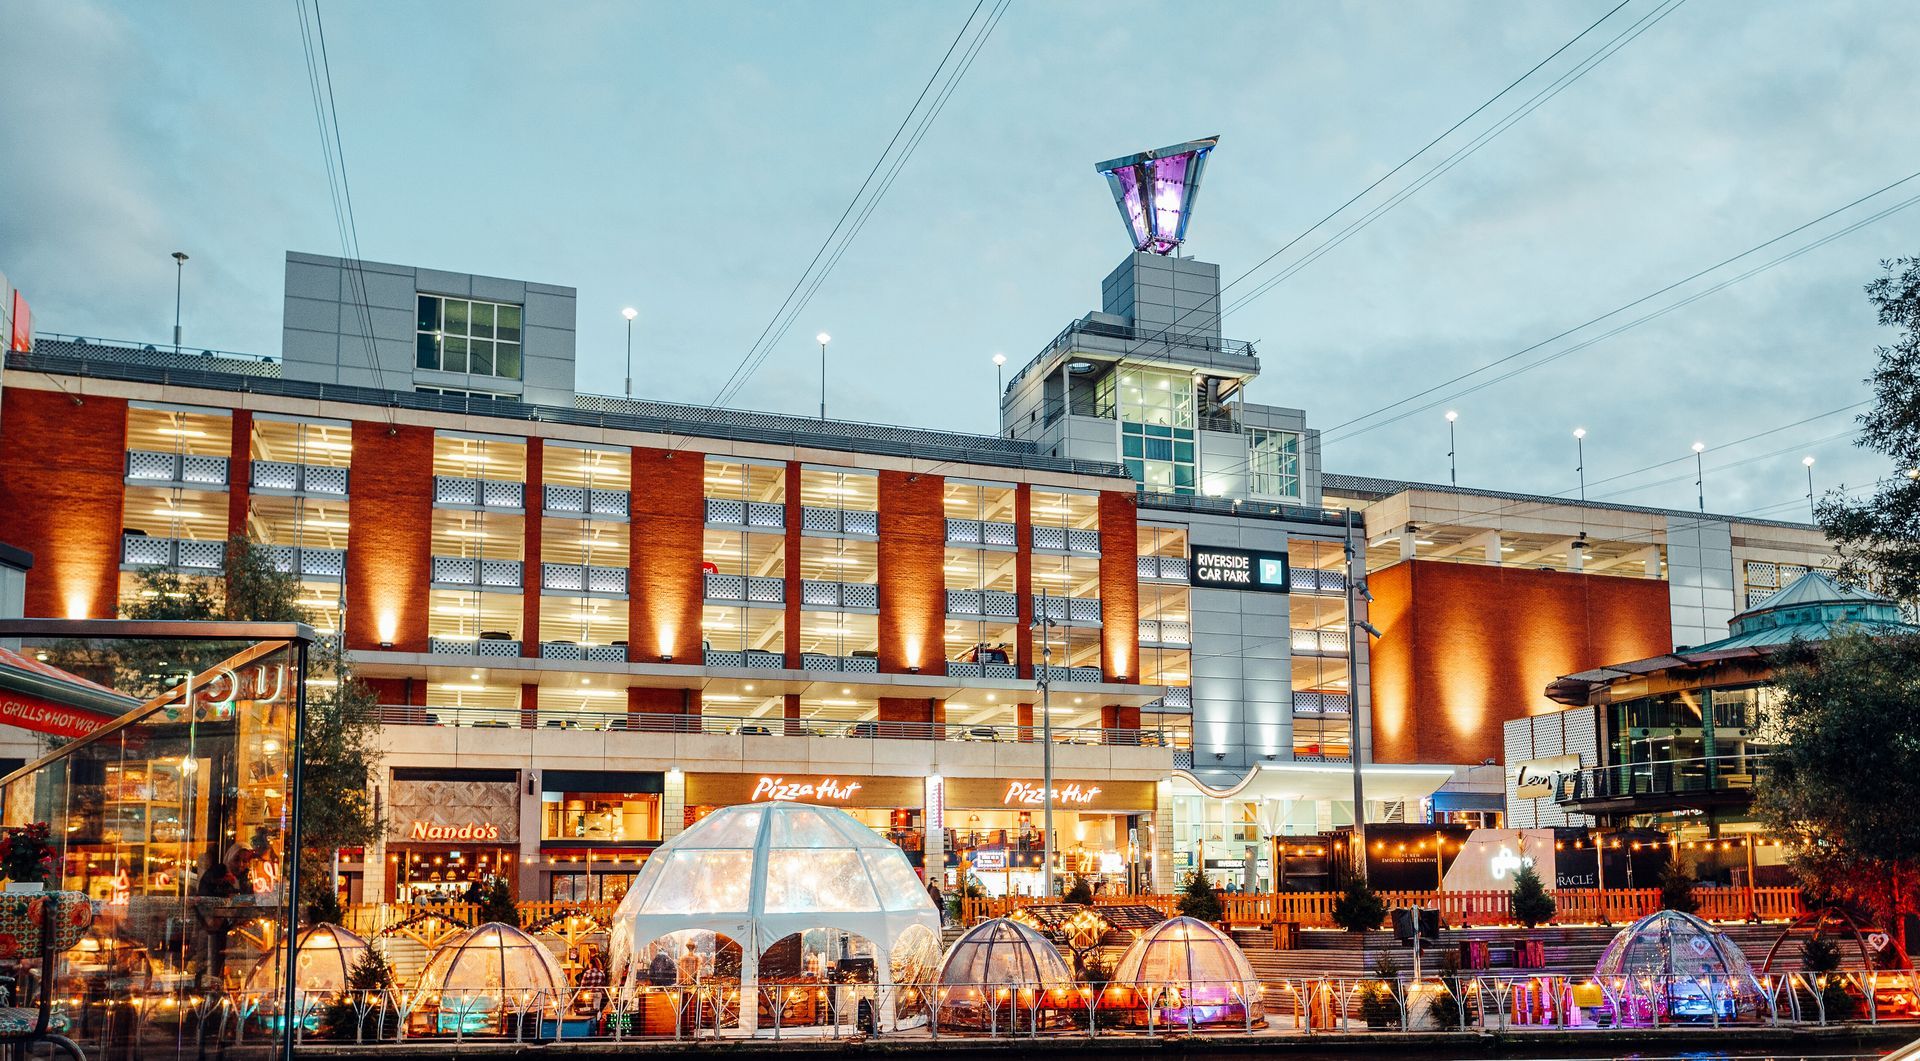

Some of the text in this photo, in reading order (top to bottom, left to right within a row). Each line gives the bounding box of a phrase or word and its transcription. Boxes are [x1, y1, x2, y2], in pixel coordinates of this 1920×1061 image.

[1197, 553, 1249, 569] RIVERSIDE
[1198, 568, 1250, 583] CAR PARK
[1265, 563, 1277, 580] P
[2, 701, 106, 733] GRILLS HOT WRA
[752, 777, 862, 801] Pizza Hut
[1004, 782, 1102, 804] Pizza Hut
[410, 821, 498, 839] Nando's
